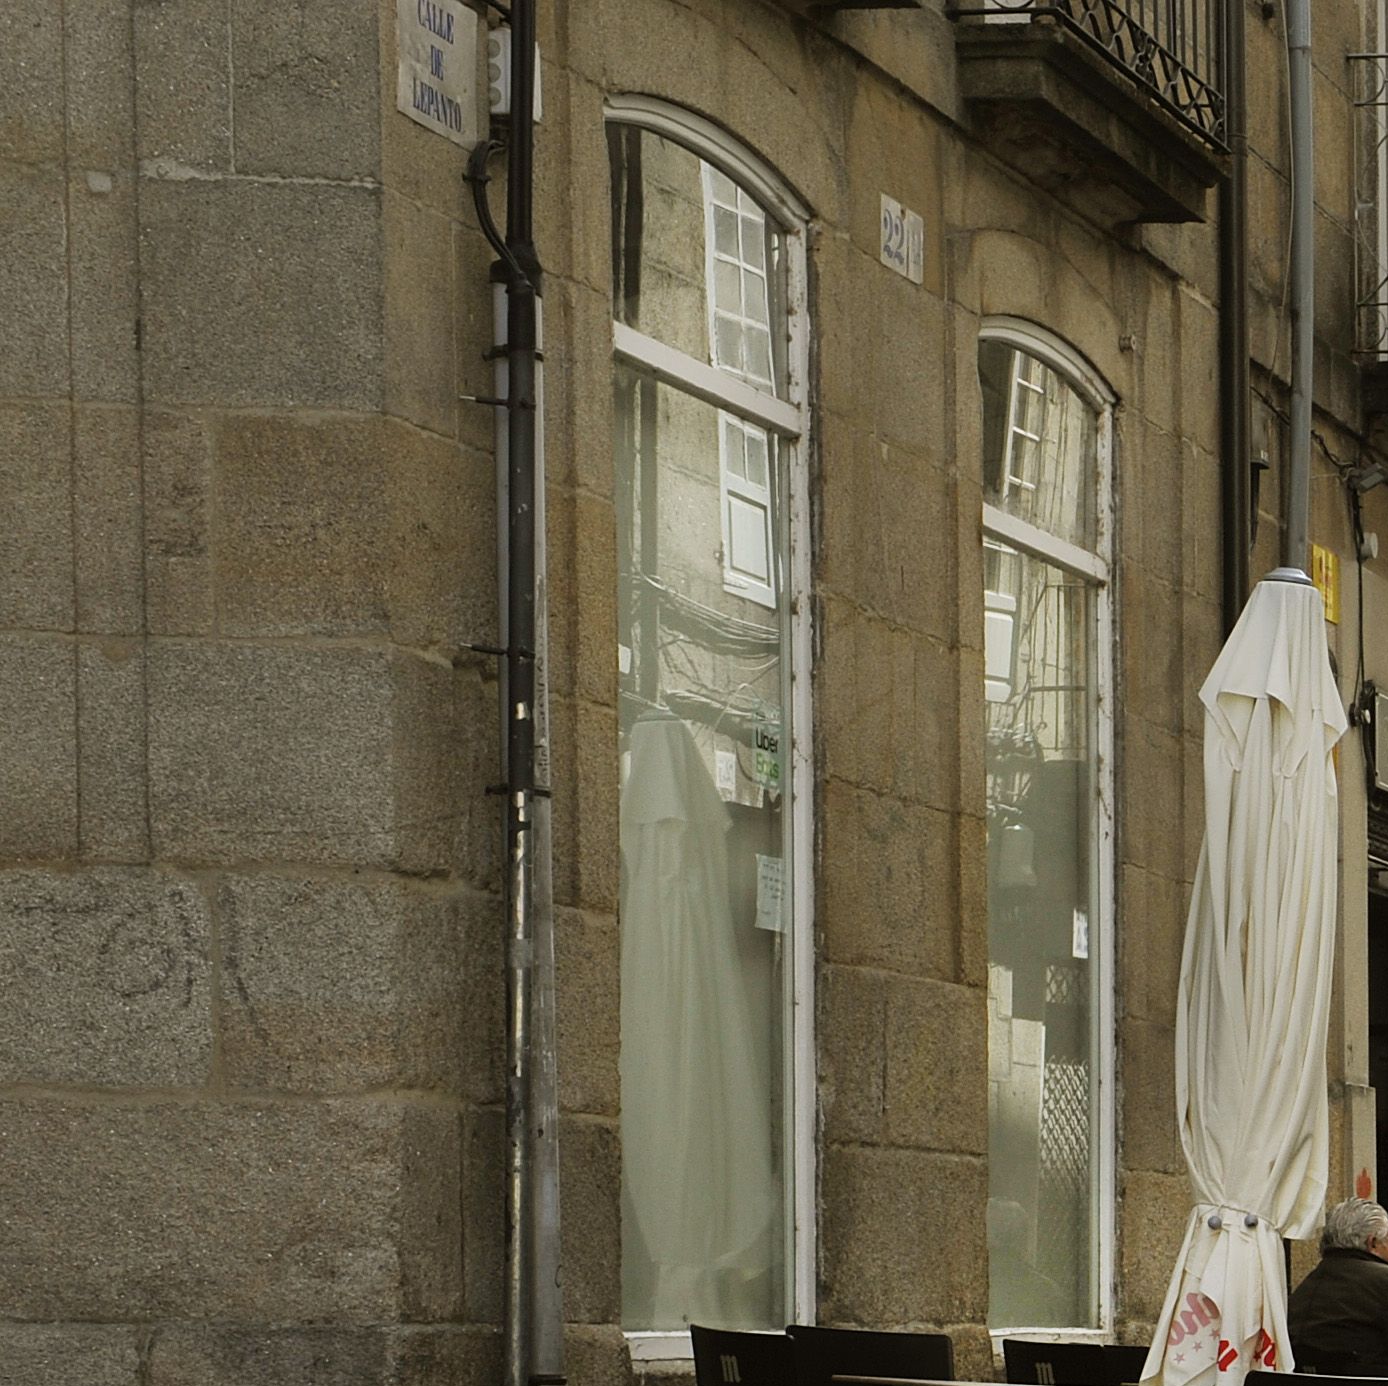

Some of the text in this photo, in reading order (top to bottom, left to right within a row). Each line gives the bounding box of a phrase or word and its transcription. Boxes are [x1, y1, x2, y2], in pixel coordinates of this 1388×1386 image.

[418, 0, 454, 45] CALLE
[431, 44, 444, 80] DE
[412, 76, 462, 132] LEPANTO
[883, 208, 905, 265] 22
[755, 727, 779, 753] Uber
